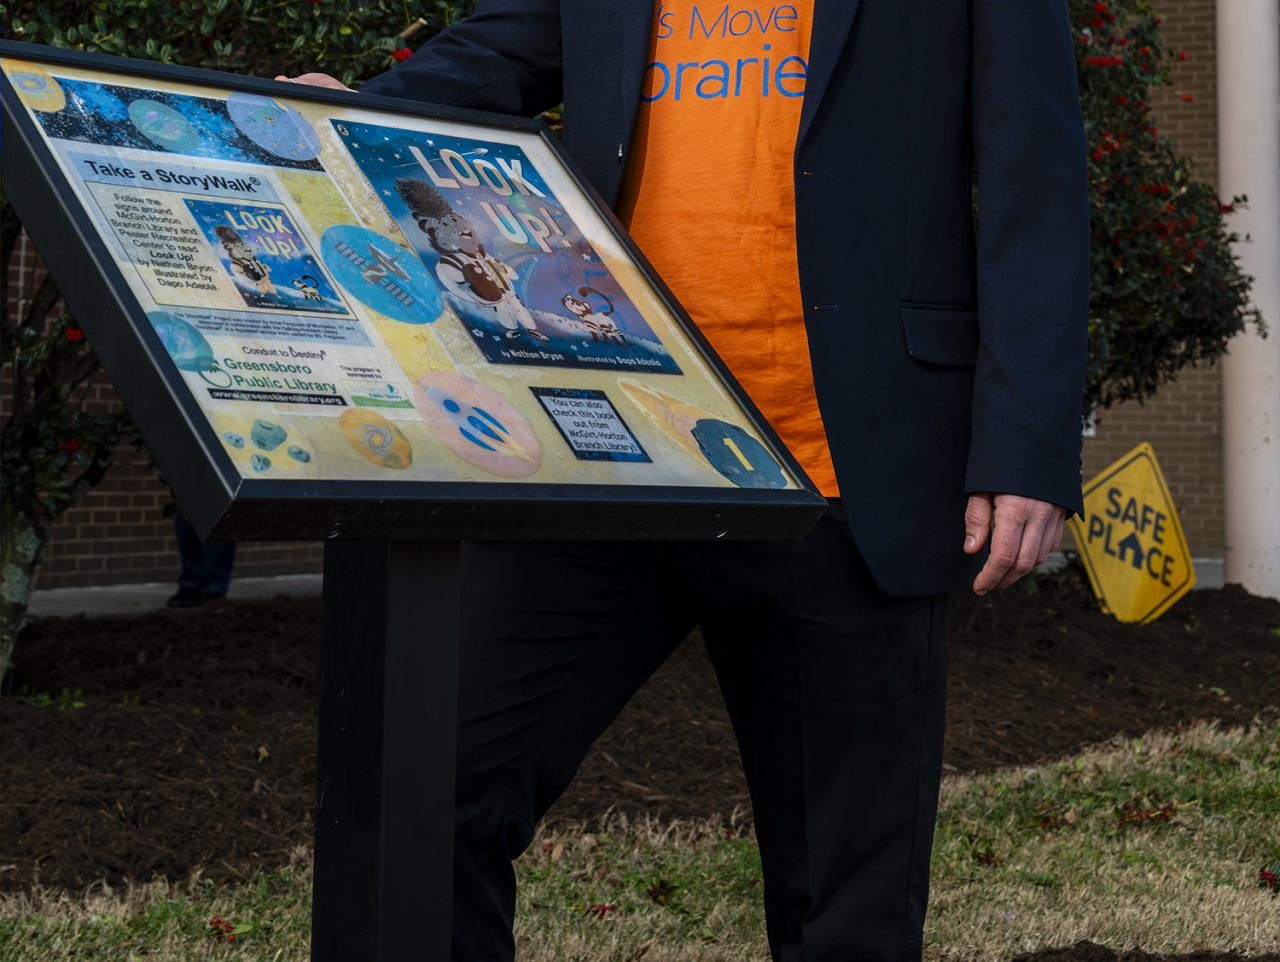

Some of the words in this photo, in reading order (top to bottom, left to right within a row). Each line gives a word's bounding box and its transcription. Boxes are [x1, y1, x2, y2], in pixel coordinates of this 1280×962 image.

[689, 4, 798, 39] Move
[85, 159, 135, 179] Take
[142, 169, 154, 182] a
[409, 145, 546, 198] LOOK
[114, 193, 145, 205] Follow
[147, 198, 162, 206] the
[114, 203, 140, 214] signs
[141, 205, 173, 216] around
[116, 211, 182, 225] McGirt-Horton
[224, 210, 293, 234] LOOK
[111, 219, 145, 230] Branch
[147, 222, 178, 235] Library
[179, 226, 198, 236] and
[152, 231, 201, 245] Recreation
[133, 239, 165, 250] Center
[166, 242, 176, 251] to
[177, 243, 198, 254] read
[150, 250, 174, 260] Look
[176, 252, 194, 262] Up!
[137, 257, 150, 268] by
[151, 259, 186, 270] Nathan
[153, 268, 199, 281] Illustrated
[200, 272, 213, 283] by
[157, 277, 184, 289] Dapo
[242, 345, 279, 357] Conduit
[280, 348, 289, 357] to
[501, 350, 511, 358] by
[510, 349, 541, 359] Nathan
[541, 351, 565, 361] Bryon
[224, 357, 312, 374] Greensboro
[233, 375, 284, 389] Public
[287, 378, 337, 394] Library
[550, 398, 568, 407] You
[585, 401, 603, 409] also
[552, 408, 578, 417] check
[579, 410, 595, 419] this
[595, 411, 617, 420] book
[573, 419, 587, 428] out
[589, 420, 610, 429] from
[568, 429, 629, 441] McGirt-Horton
[573, 439, 604, 449] Branch
[604, 442, 638, 452] Library!
[723, 438, 754, 471] 1
[1105, 488, 1166, 544] SAFE
